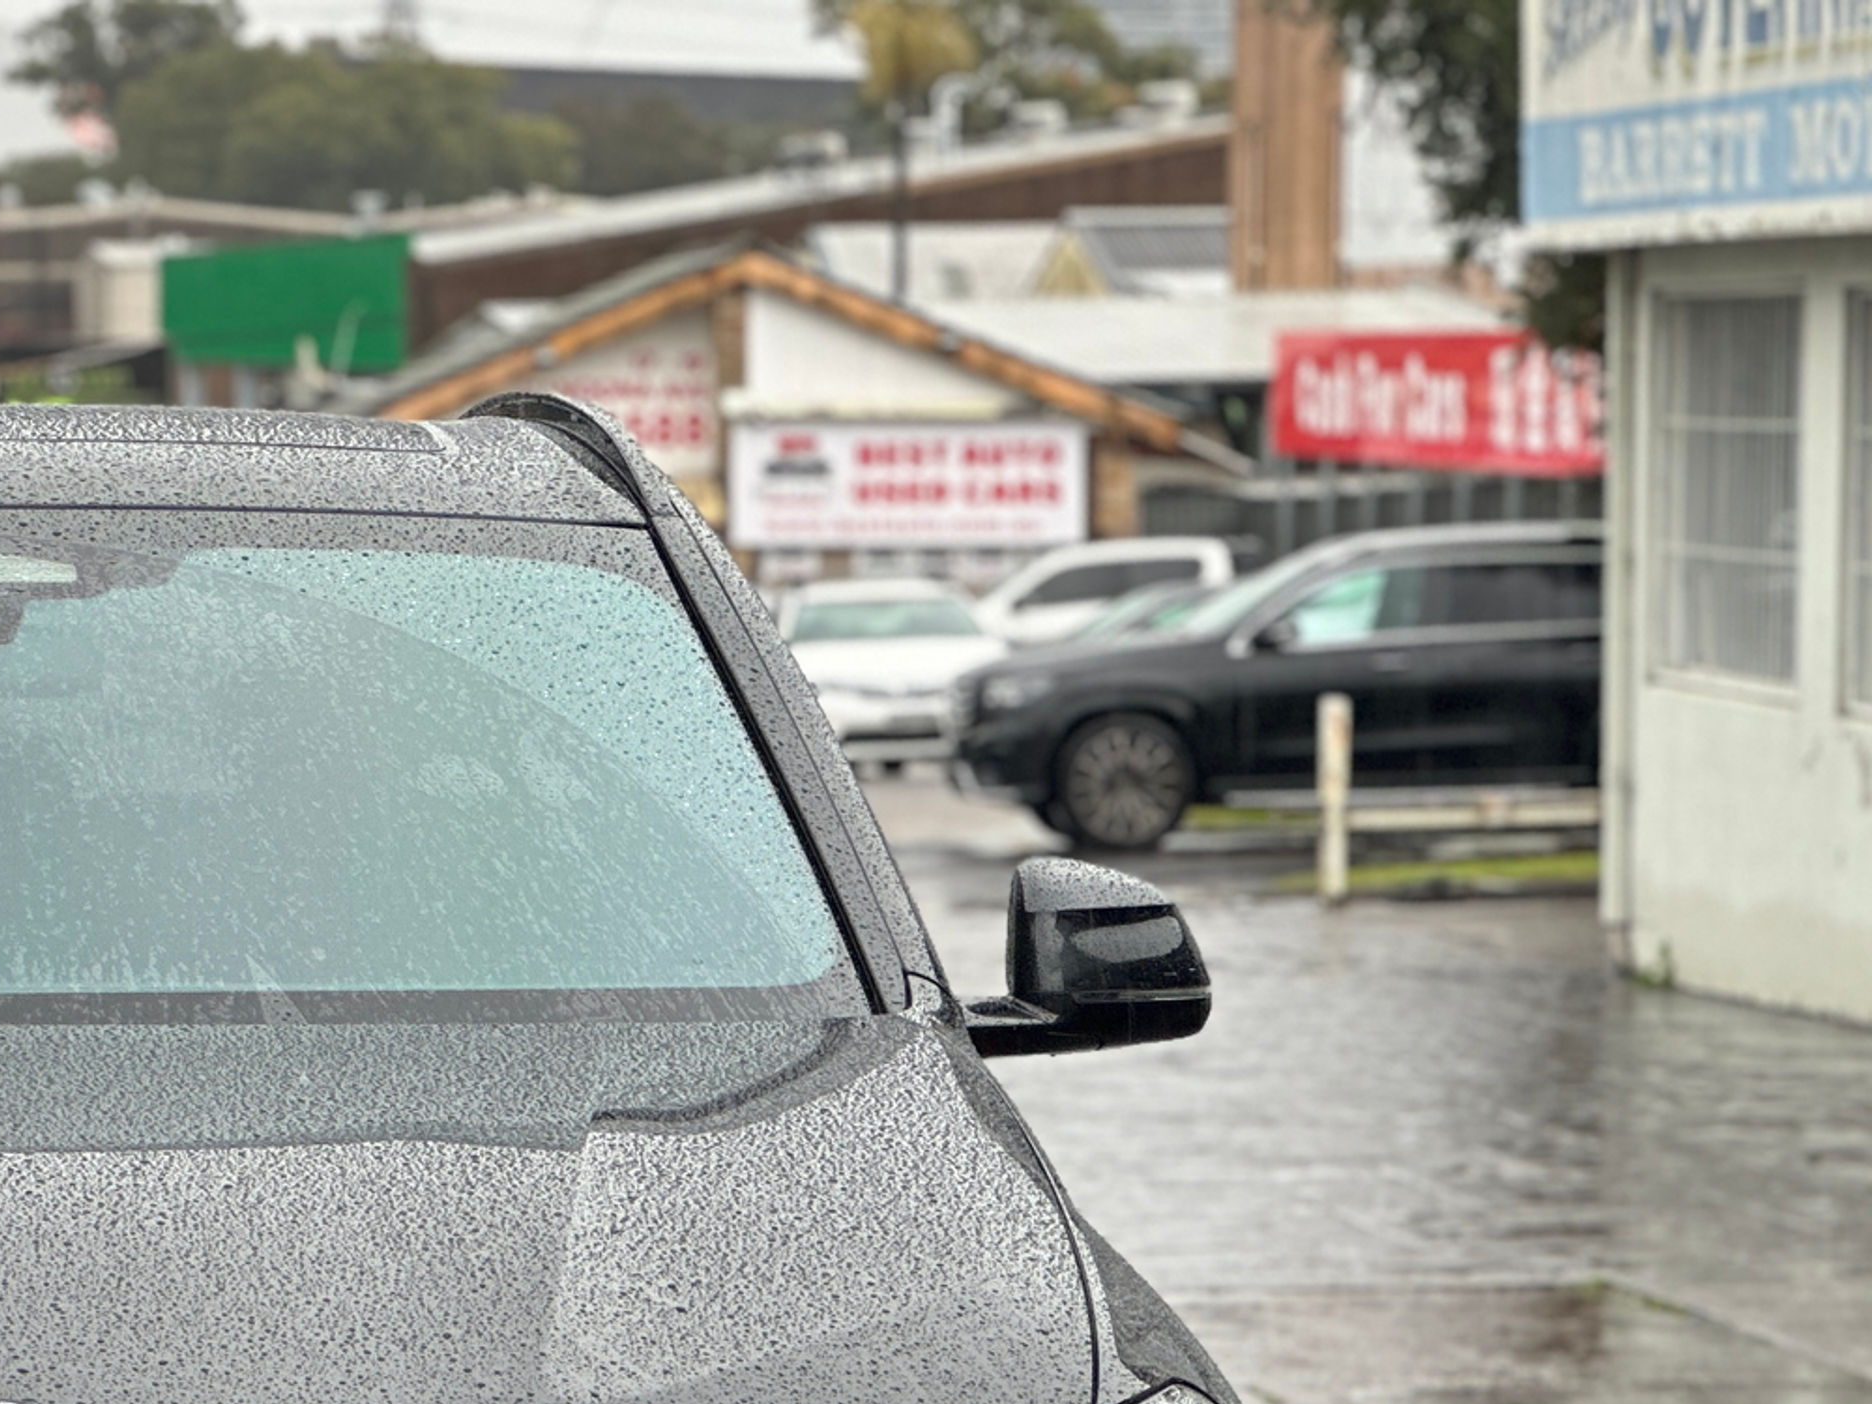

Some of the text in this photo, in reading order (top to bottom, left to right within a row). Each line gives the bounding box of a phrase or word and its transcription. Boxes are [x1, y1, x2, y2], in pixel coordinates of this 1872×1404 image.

[1579, 96, 1872, 206] BARRETT MO
[853, 437, 948, 468] BEST
[962, 437, 1063, 467] AUTO
[853, 477, 950, 504] USED
[961, 477, 1063, 504] CARS
